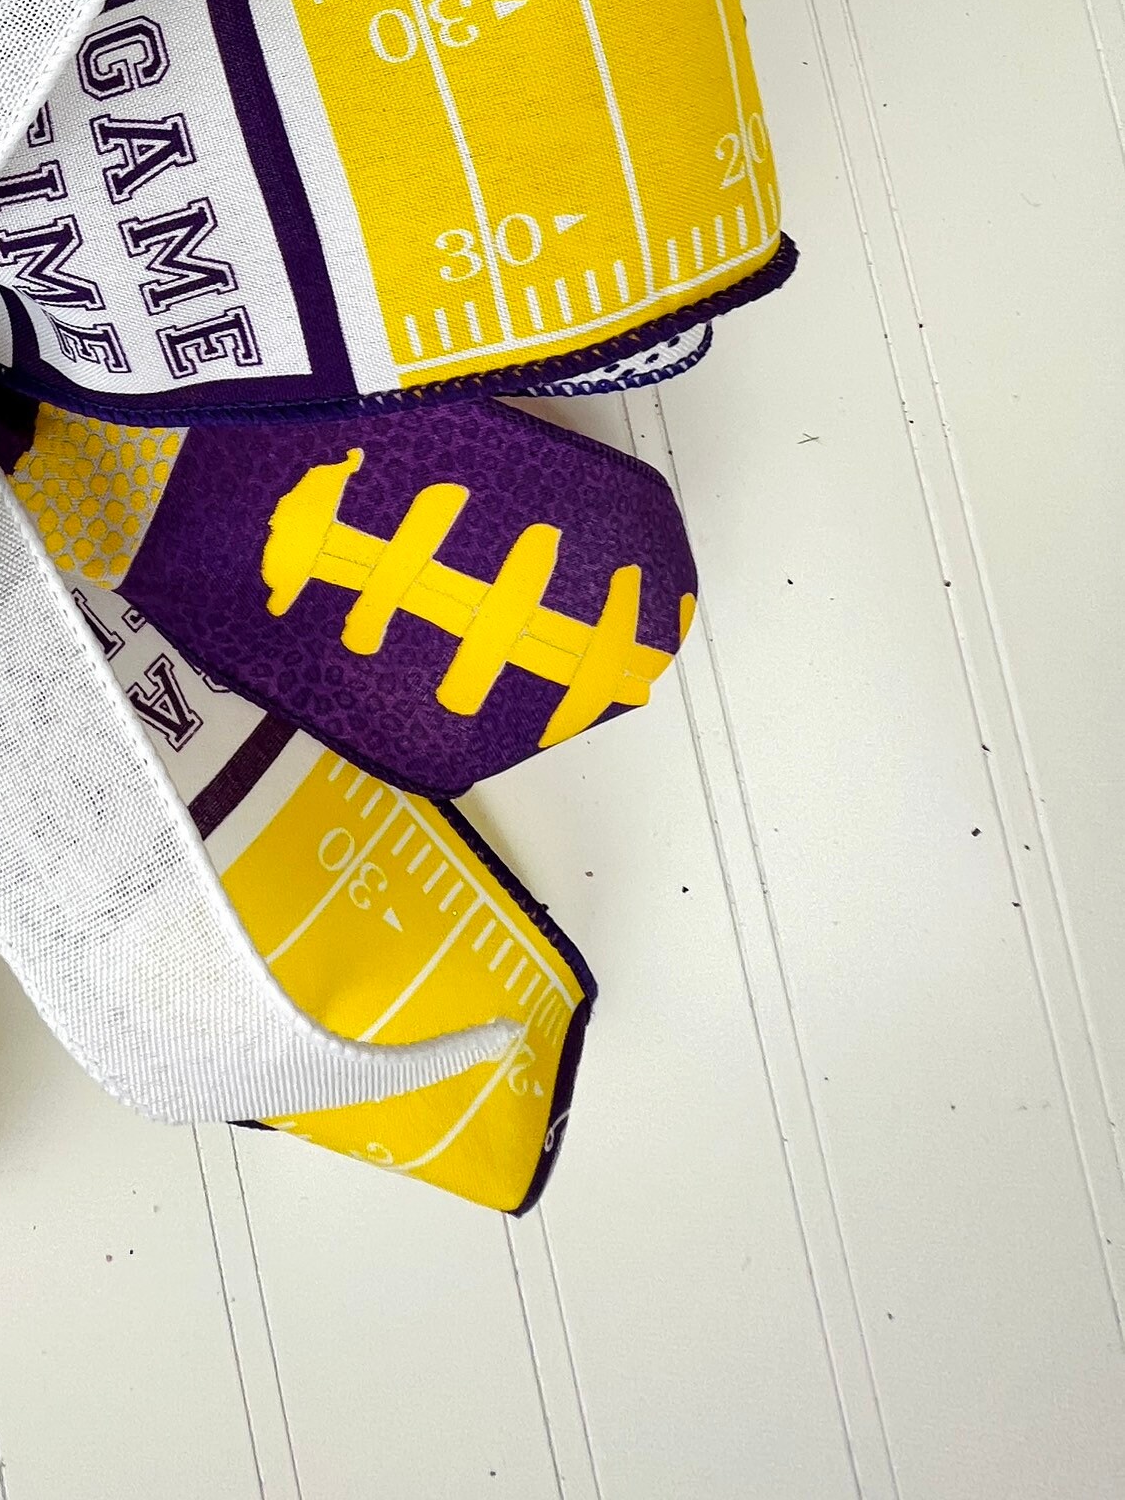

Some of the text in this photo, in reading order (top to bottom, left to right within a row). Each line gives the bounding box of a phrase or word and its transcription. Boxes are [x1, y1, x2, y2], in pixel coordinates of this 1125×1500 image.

[714, 112, 767, 190] 20
[76, 15, 263, 379] GAME
[433, 211, 544, 284] 30
[317, 826, 389, 911] 30
